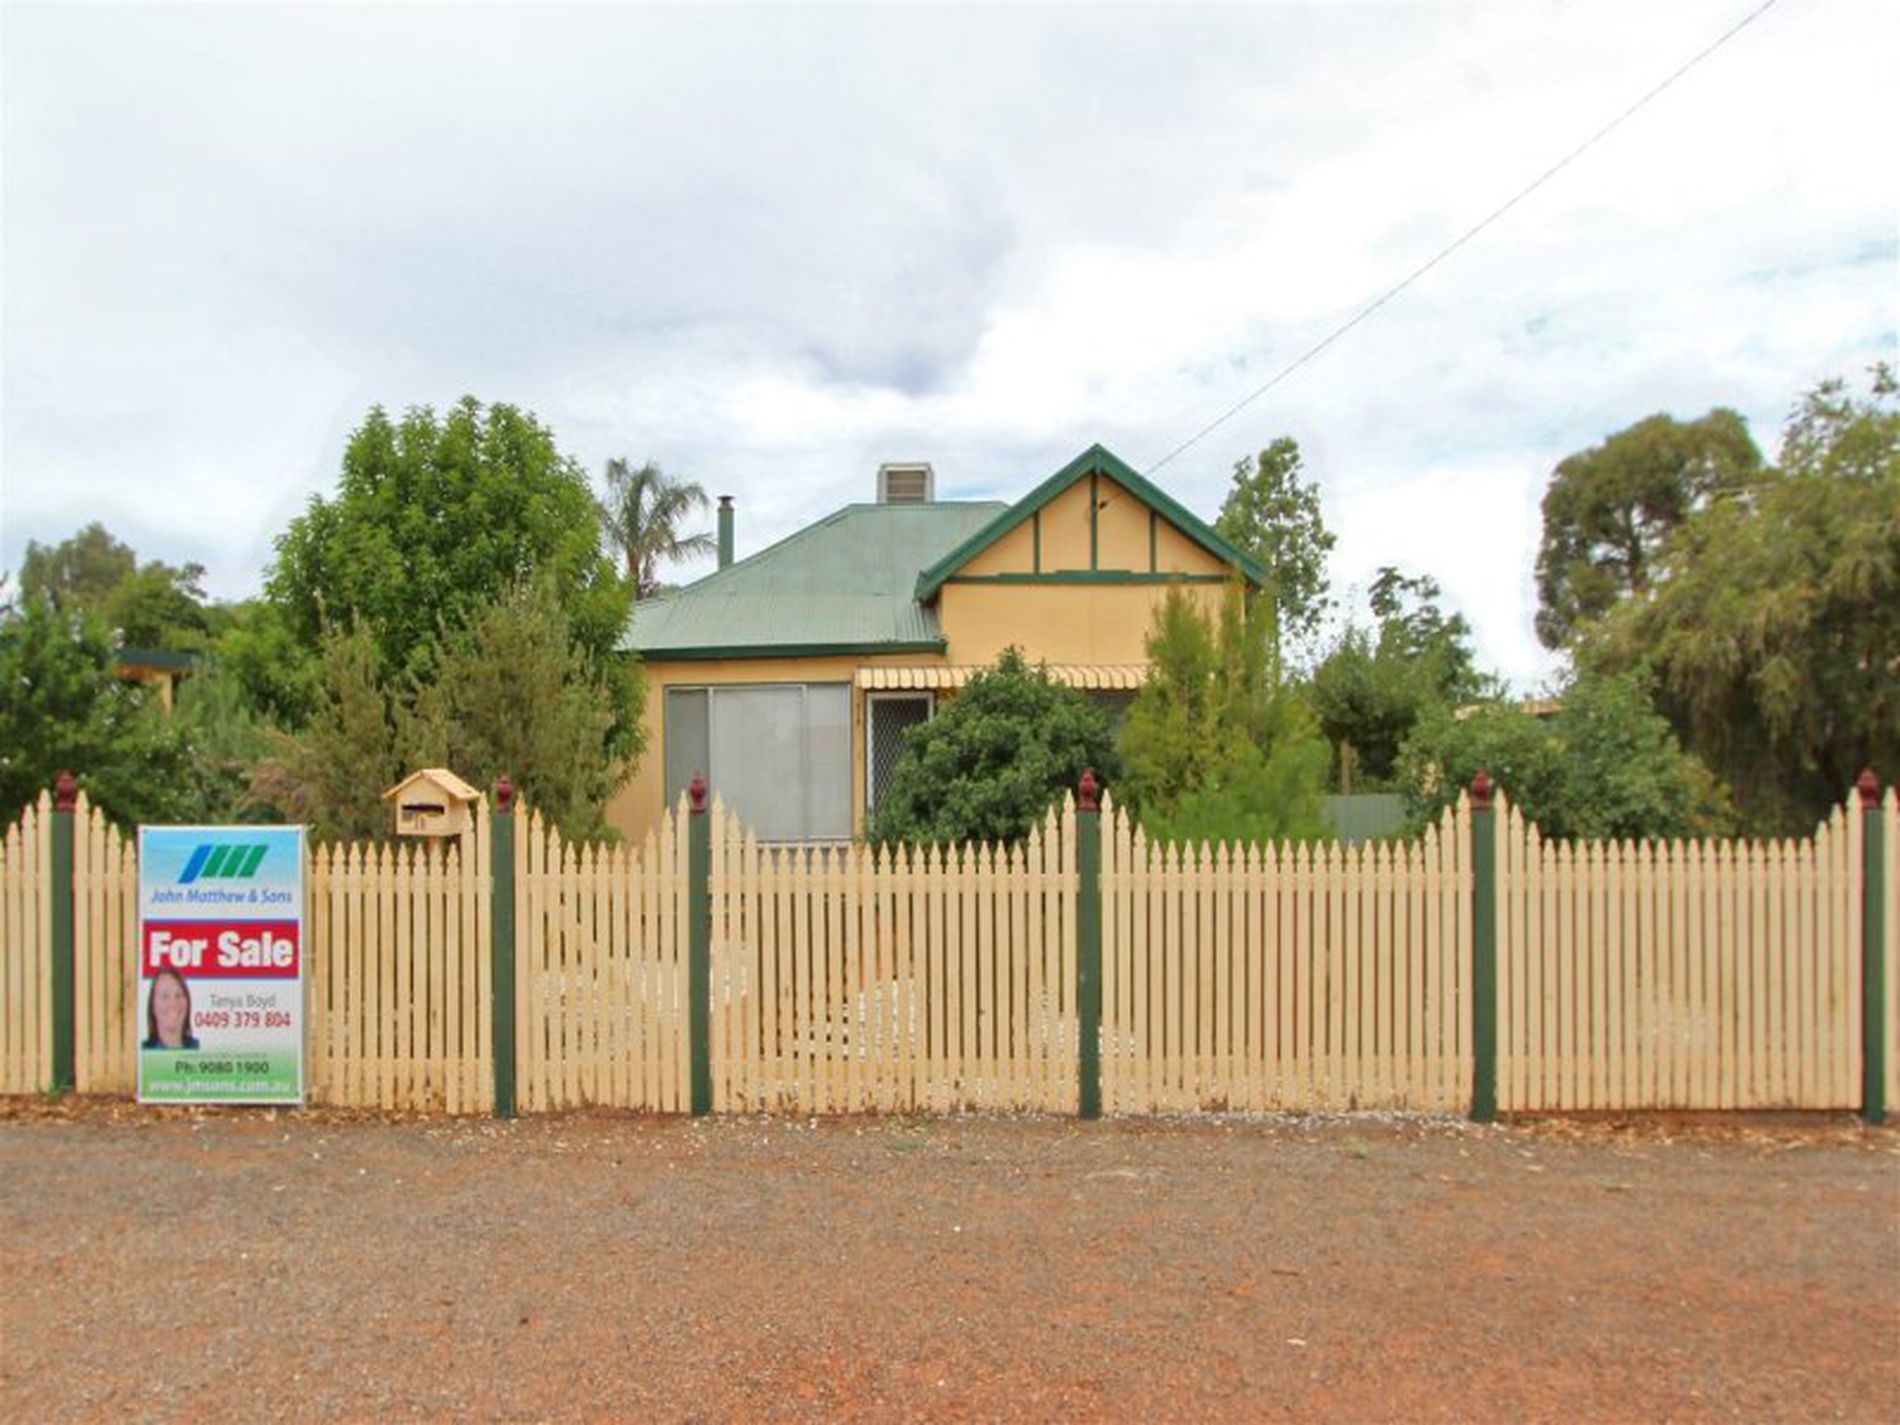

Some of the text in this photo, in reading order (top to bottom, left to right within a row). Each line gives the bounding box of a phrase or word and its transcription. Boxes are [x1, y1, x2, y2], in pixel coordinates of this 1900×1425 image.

[152, 889, 293, 905] John Matthew & Sons
[151, 931, 294, 968] For Sale
[210, 993, 276, 1010] Tanya Boyd
[194, 1011, 292, 1027] 0409 379 804
[199, 1061, 233, 1074] 9080
[236, 1061, 269, 1074] 1900
